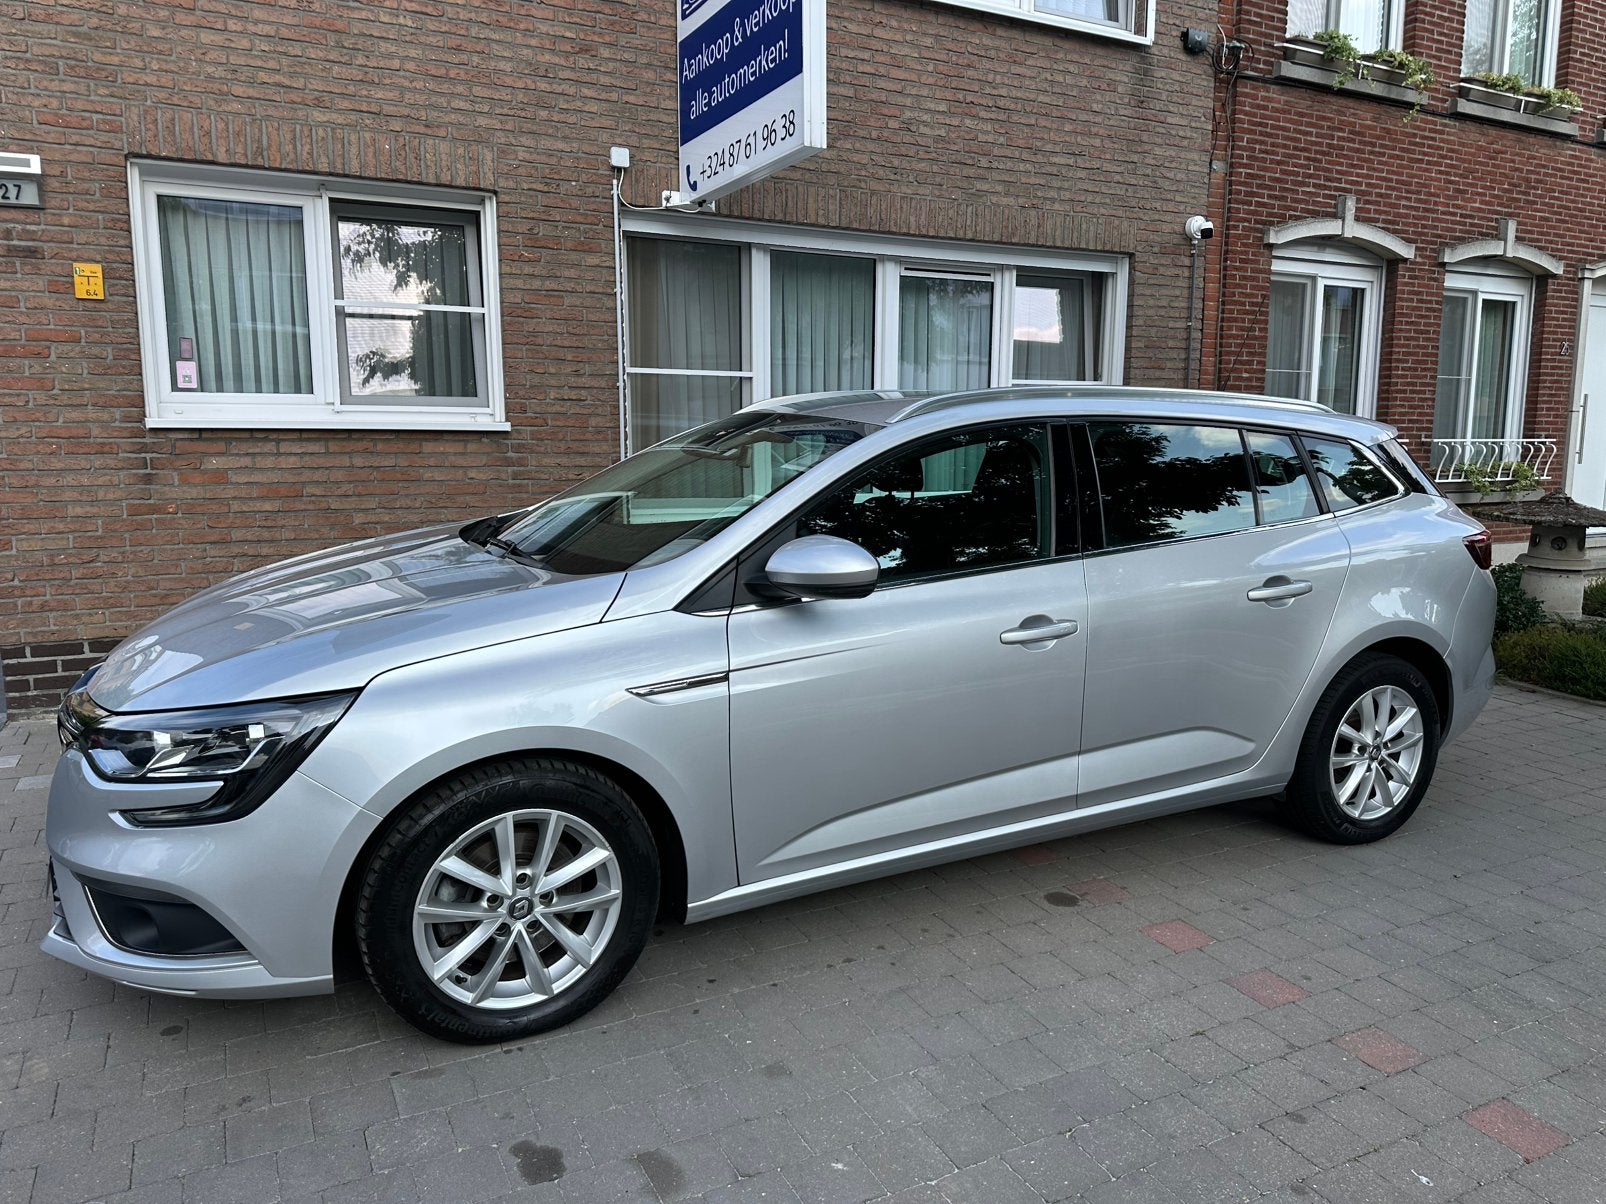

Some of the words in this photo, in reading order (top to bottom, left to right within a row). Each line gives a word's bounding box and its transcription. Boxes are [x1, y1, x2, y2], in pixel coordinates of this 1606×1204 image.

[682, 32, 731, 85] Aankoop
[733, 17, 743, 46] &
[690, 88, 709, 120] alle
[711, 28, 788, 107] automerken!
[700, 147, 726, 182] +324
[728, 138, 742, 168] 87
[744, 129, 757, 160] 61
[762, 118, 777, 151] 96
[780, 109, 796, 141] 38
[0, 183, 21, 200] 27
